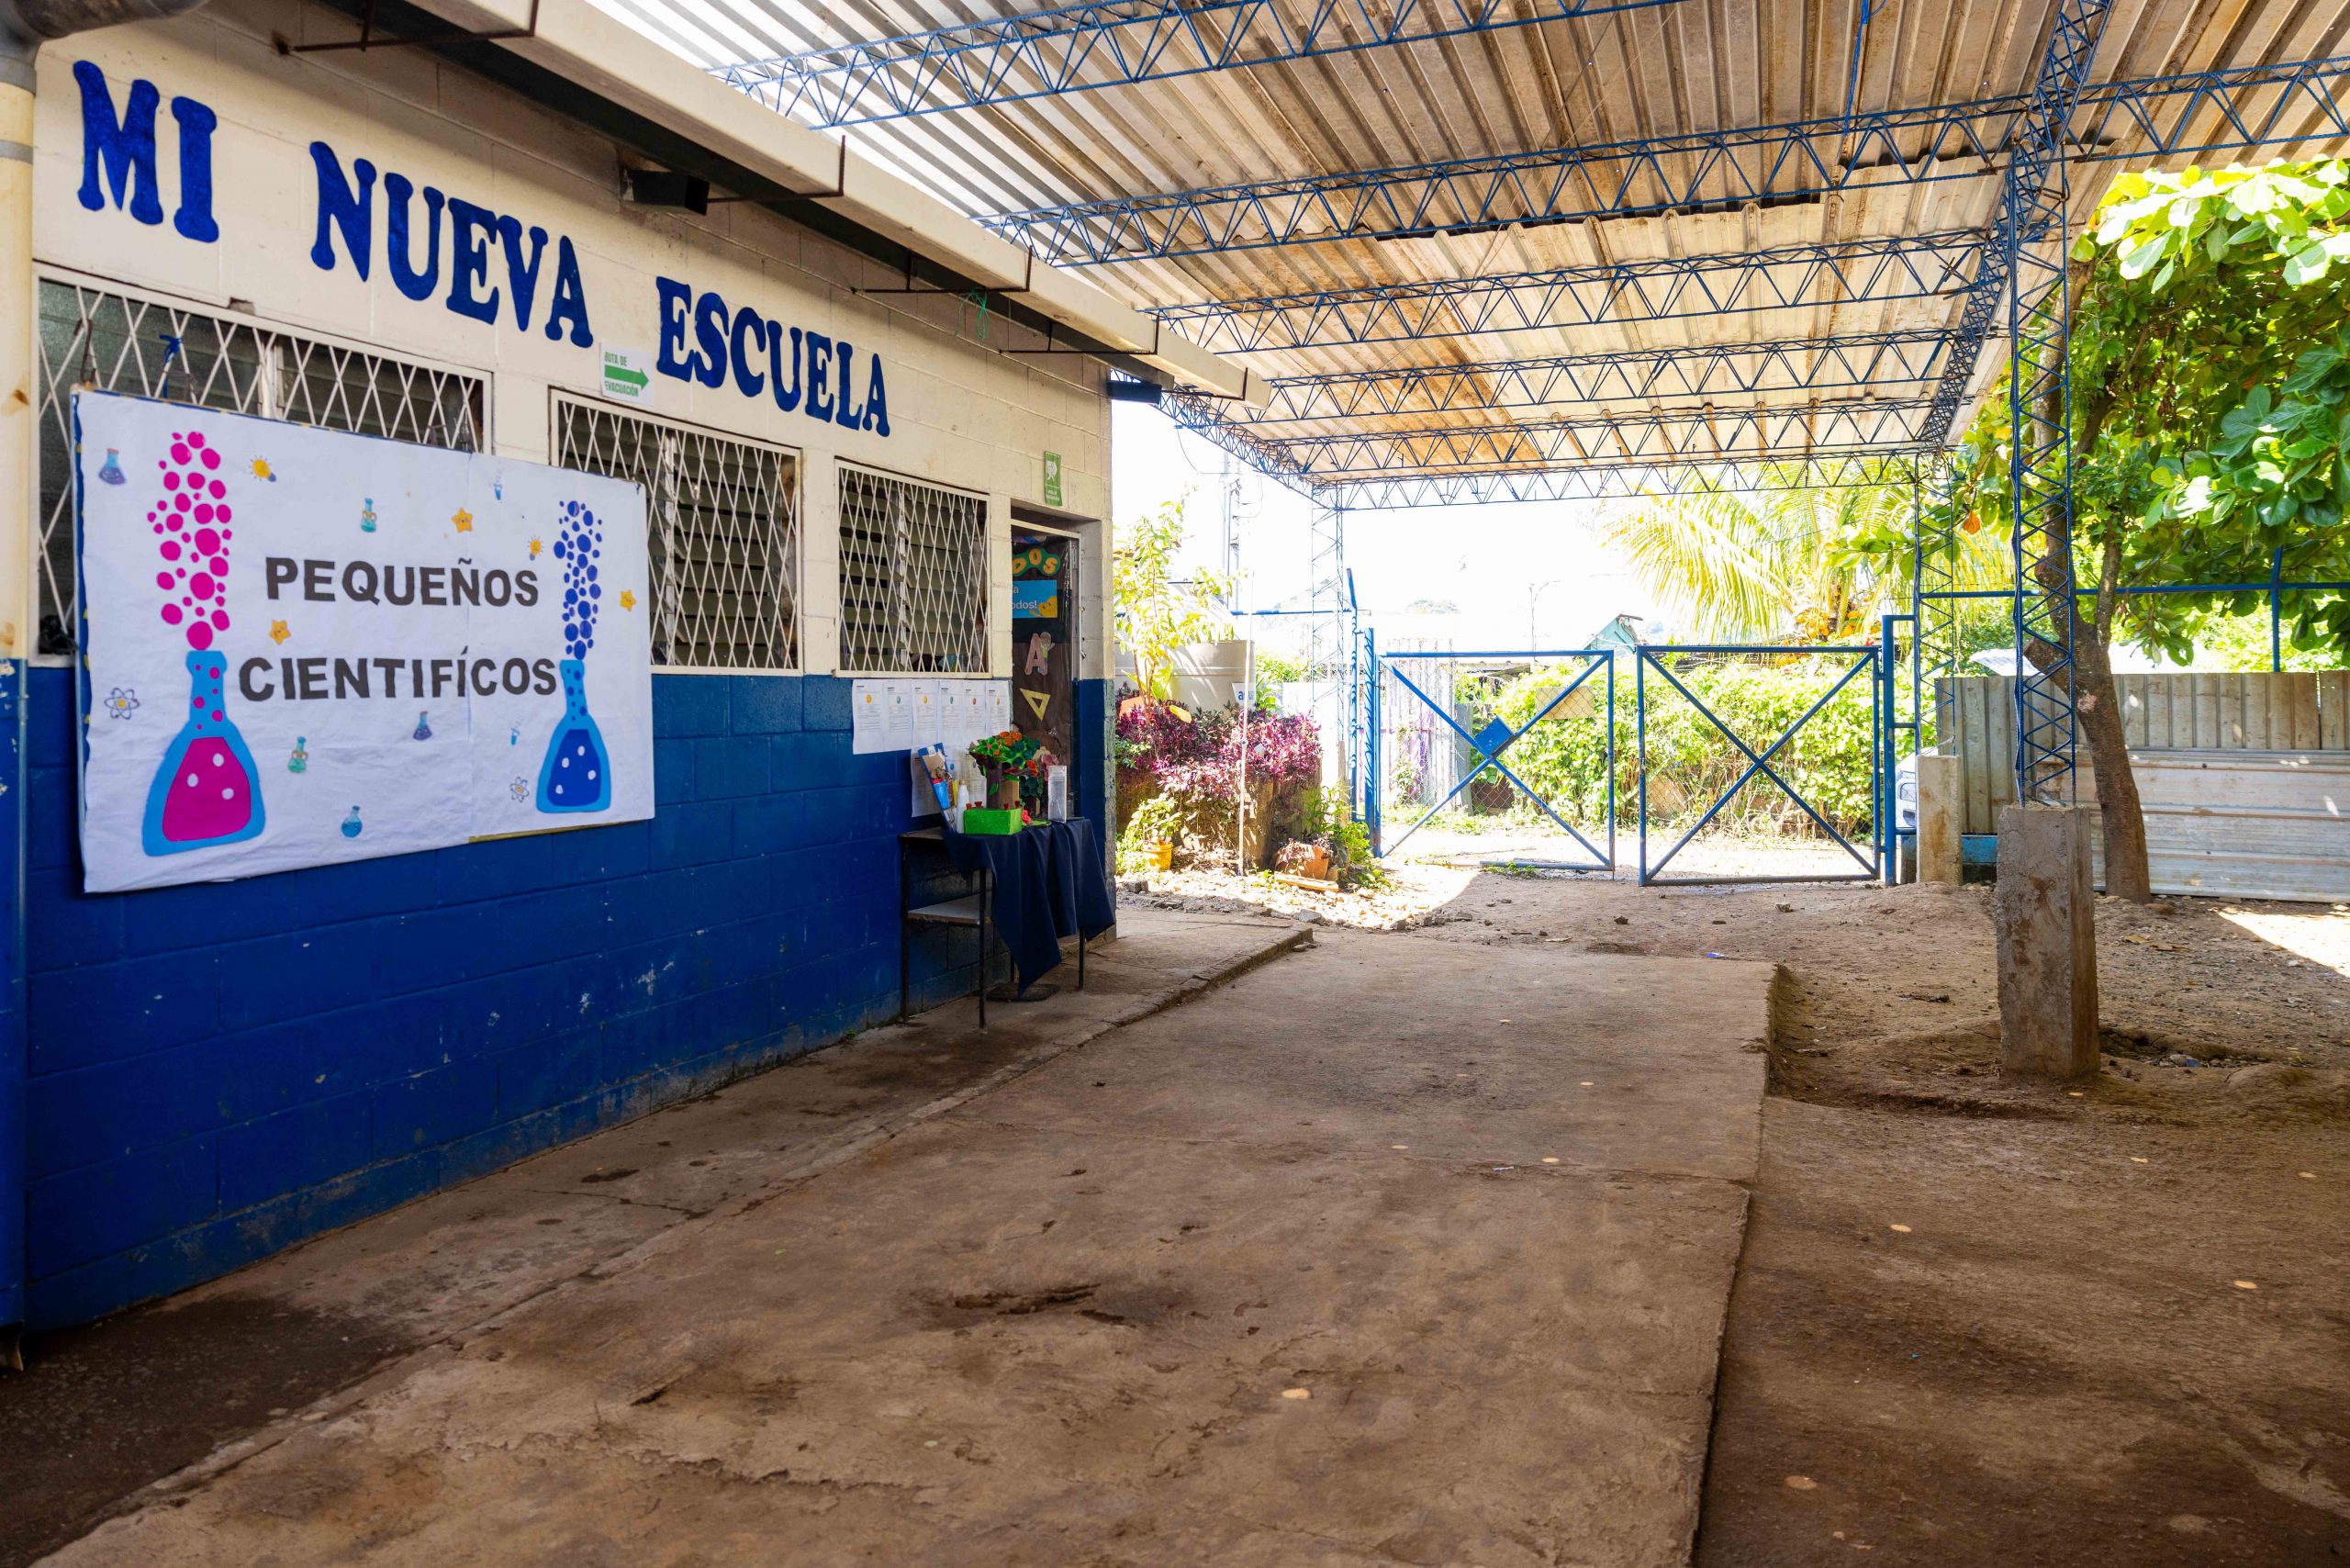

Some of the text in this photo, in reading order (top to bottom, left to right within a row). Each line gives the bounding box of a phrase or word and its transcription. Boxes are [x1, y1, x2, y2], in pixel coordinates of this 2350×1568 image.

[73, 60, 890, 438] MI NUEVA ESCUELA
[620, 355, 628, 367] DE
[265, 556, 539, 608] PEQUEÑOS
[238, 645, 557, 702] CIENTIFÍCOS
